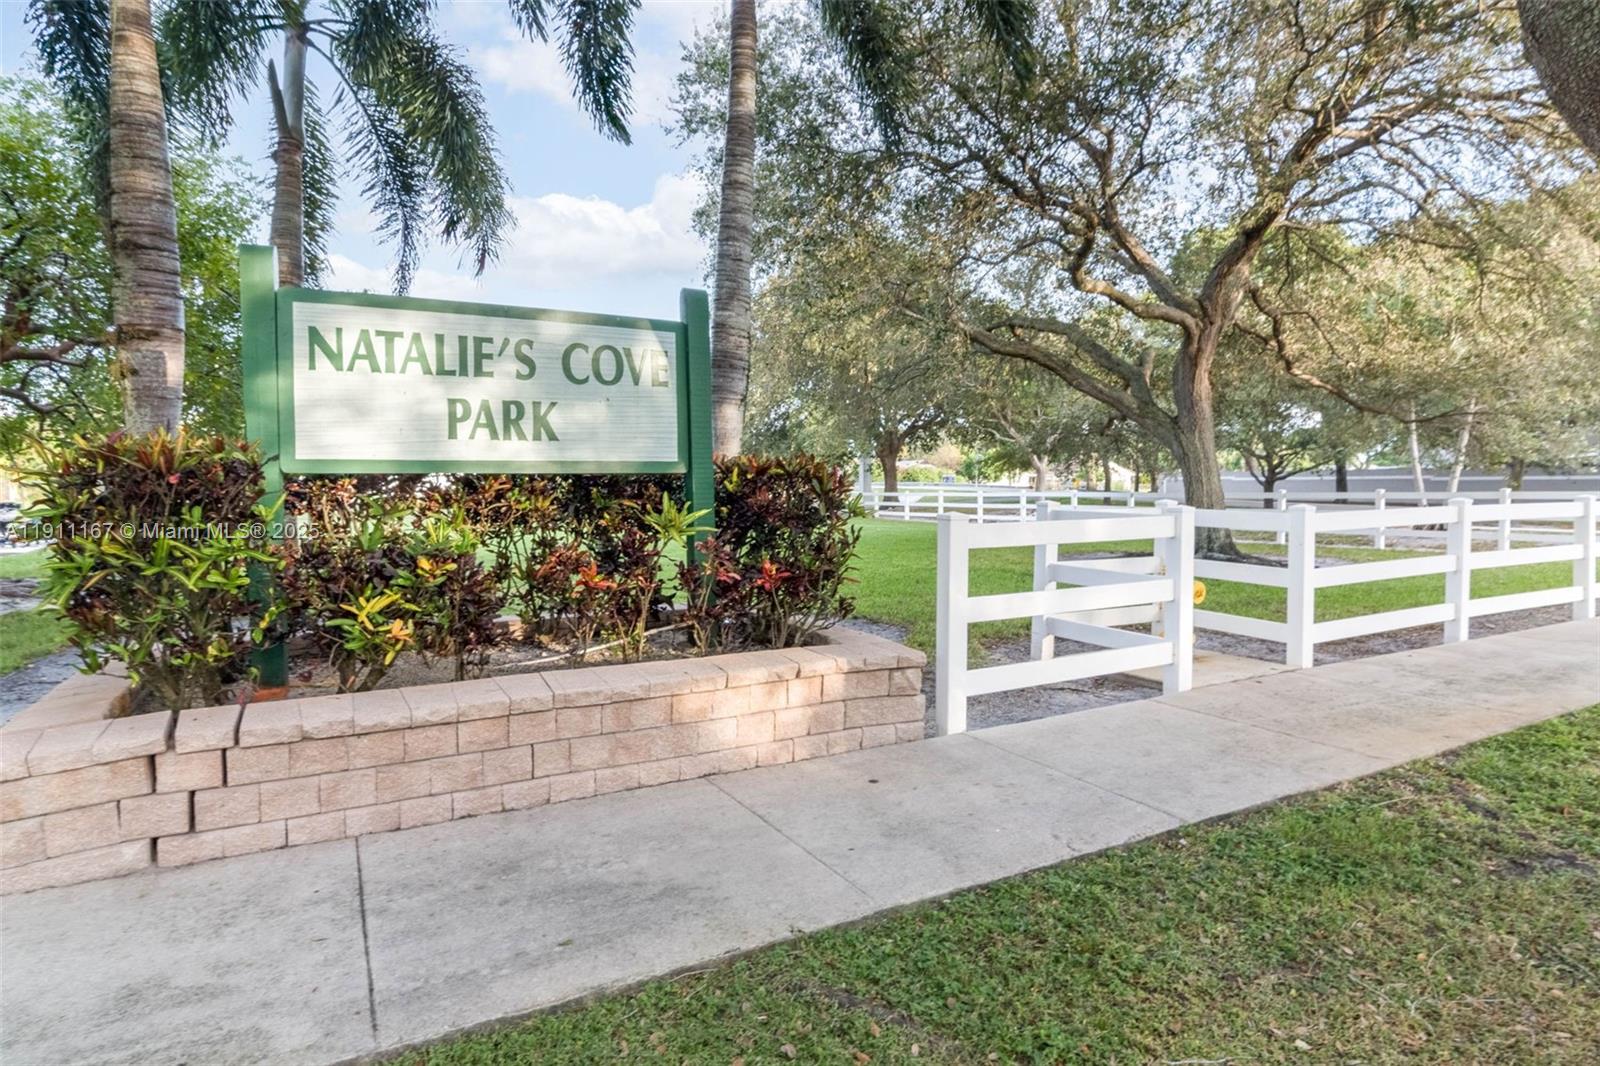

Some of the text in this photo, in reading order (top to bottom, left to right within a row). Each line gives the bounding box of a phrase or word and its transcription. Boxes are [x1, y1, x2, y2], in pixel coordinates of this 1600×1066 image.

[307, 326, 669, 387] NATALIE'S COVE
[447, 398, 560, 441] PARK
